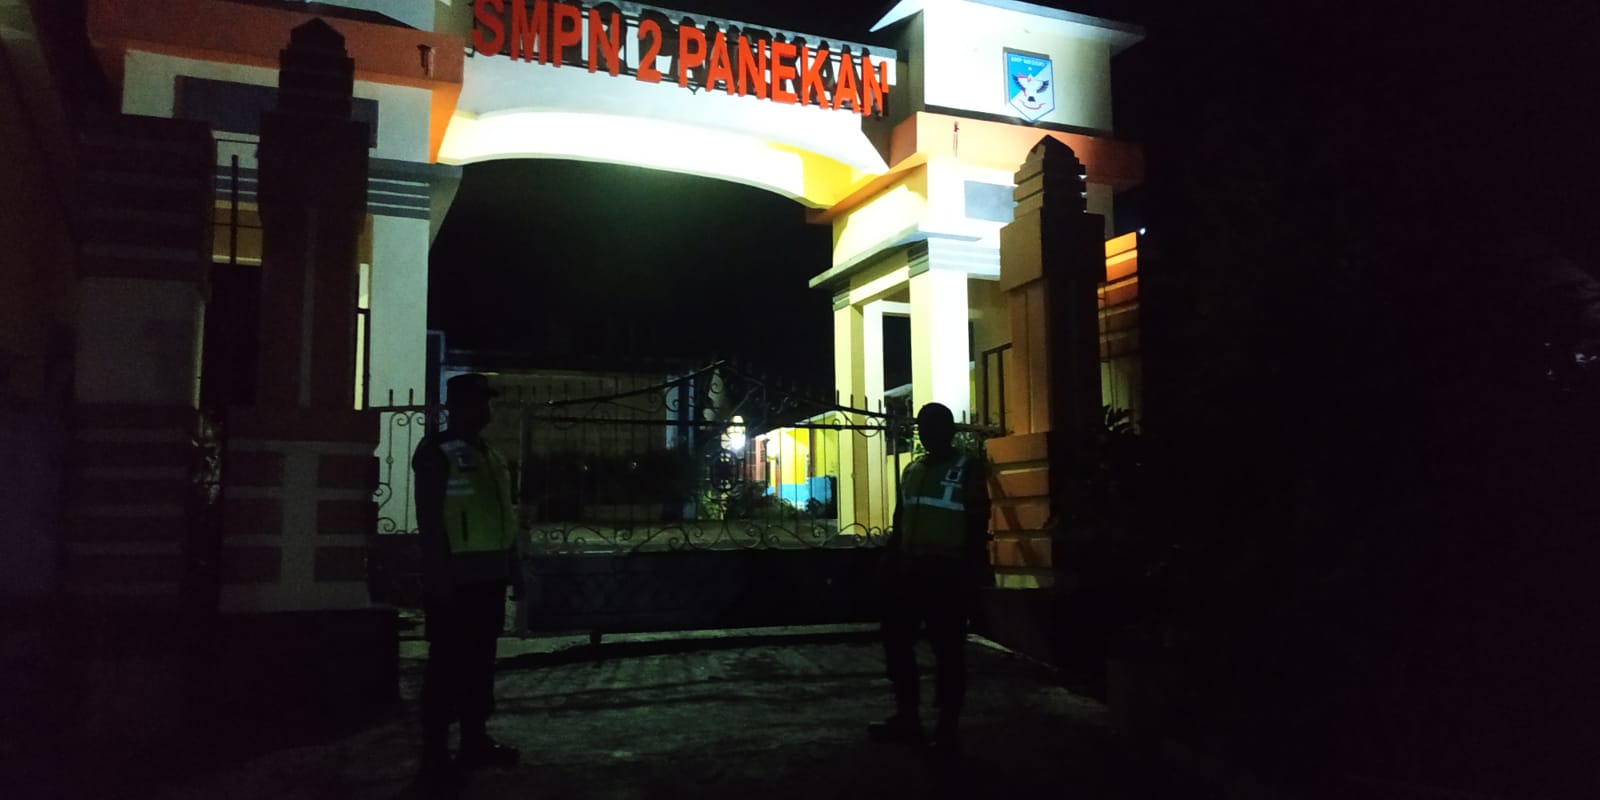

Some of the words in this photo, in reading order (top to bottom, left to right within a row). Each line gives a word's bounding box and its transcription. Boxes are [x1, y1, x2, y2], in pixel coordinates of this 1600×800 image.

[472, 0, 620, 76] SMPN
[636, 19, 663, 82] 2
[678, 26, 889, 116] PANEKAN
